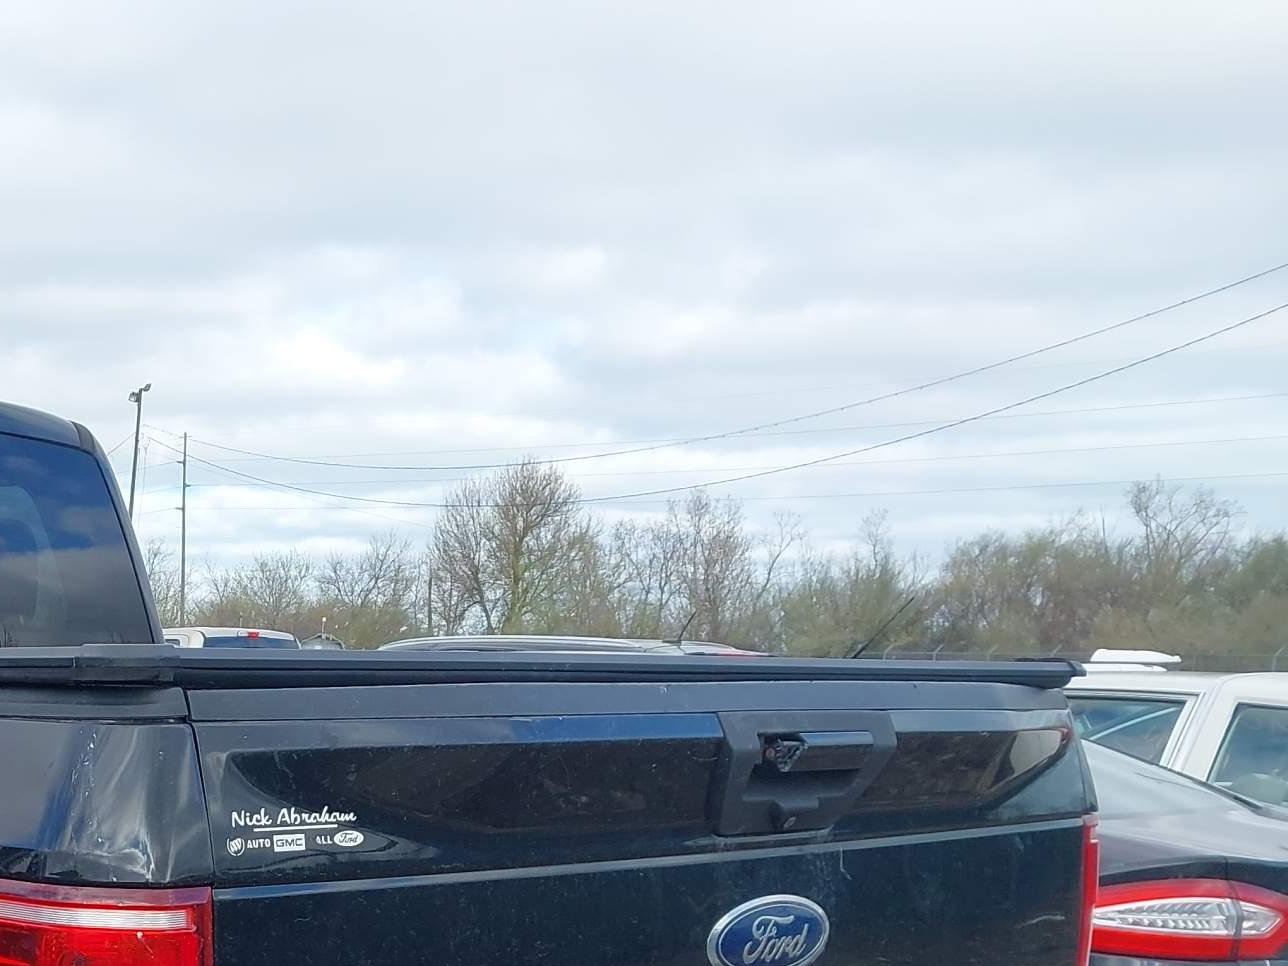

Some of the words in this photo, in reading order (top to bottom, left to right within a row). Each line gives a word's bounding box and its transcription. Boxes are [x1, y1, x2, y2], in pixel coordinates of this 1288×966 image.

[231, 808, 272, 828] Nick
[277, 805, 357, 825] Abraham
[246, 838, 271, 849] AUTO
[275, 837, 304, 848] GMC
[743, 915, 809, 964] Ford
